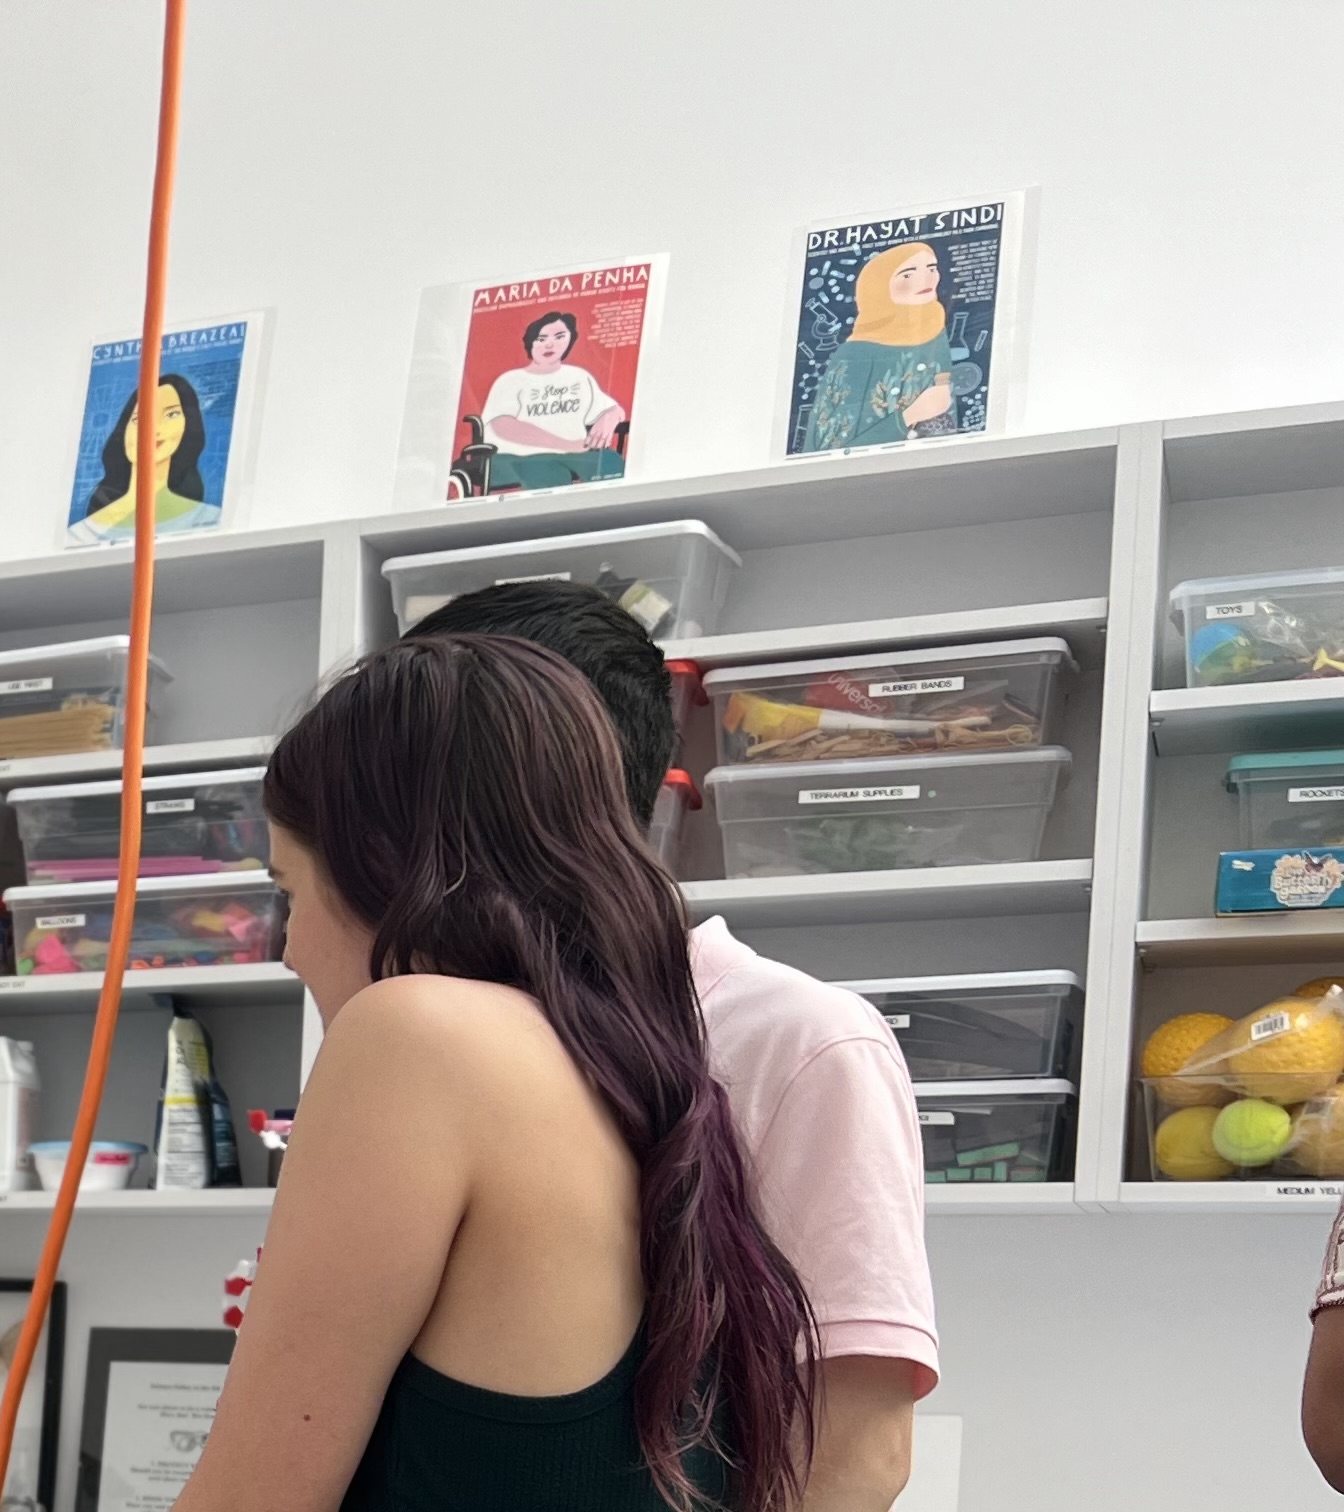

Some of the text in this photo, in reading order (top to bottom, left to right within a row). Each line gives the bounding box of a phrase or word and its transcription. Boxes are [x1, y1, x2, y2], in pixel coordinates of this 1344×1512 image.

[934, 203, 1003, 231] SINDI
[474, 281, 540, 307] MARIA
[549, 278, 573, 295] DA
[581, 265, 649, 291] PENHA
[543, 383, 569, 399] Stop
[1215, 604, 1243, 616] TOYS
[881, 678, 953, 695] RUBBER BANDS
[809, 788, 904, 800] TERRARIUM SUPPLIES
[154, 801, 186, 811] STRAWS
[40, 917, 77, 926] BALLOONS
[1277, 1186, 1315, 1196] MEDIUM
